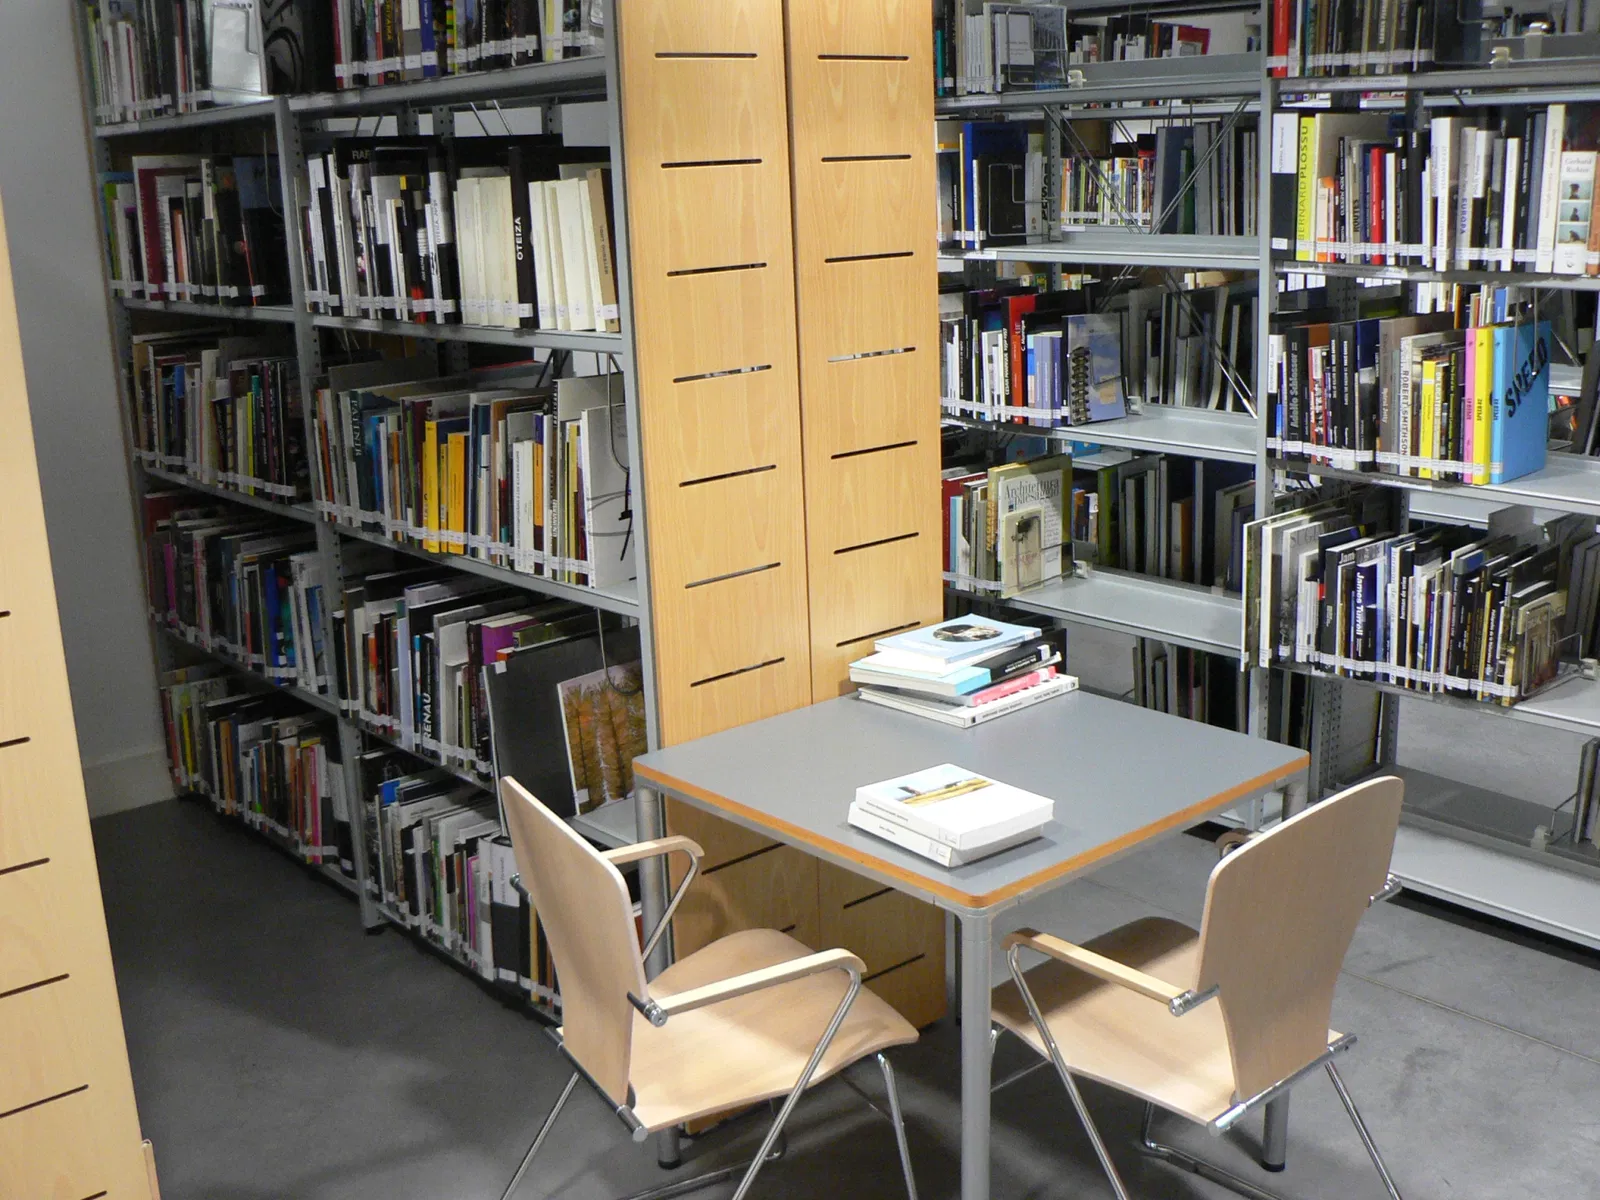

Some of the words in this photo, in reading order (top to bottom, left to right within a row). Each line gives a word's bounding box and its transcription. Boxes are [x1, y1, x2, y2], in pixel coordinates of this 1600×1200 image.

[1300, 126, 1308, 178] PLOSSU
[1298, 182, 1307, 240] BERNARD
[1460, 198, 1468, 234] EUROPA
[514, 217, 523, 260] OTEIZA
[1289, 353, 1298, 396] Schlosser
[1402, 370, 1410, 405] ROBERT
[1289, 397, 1299, 428] Adolfo
[1401, 410, 1409, 456] SMITHSON
[1356, 572, 1365, 604] James
[1356, 604, 1364, 635] Turrell
[422, 692, 432, 739] RENAU
